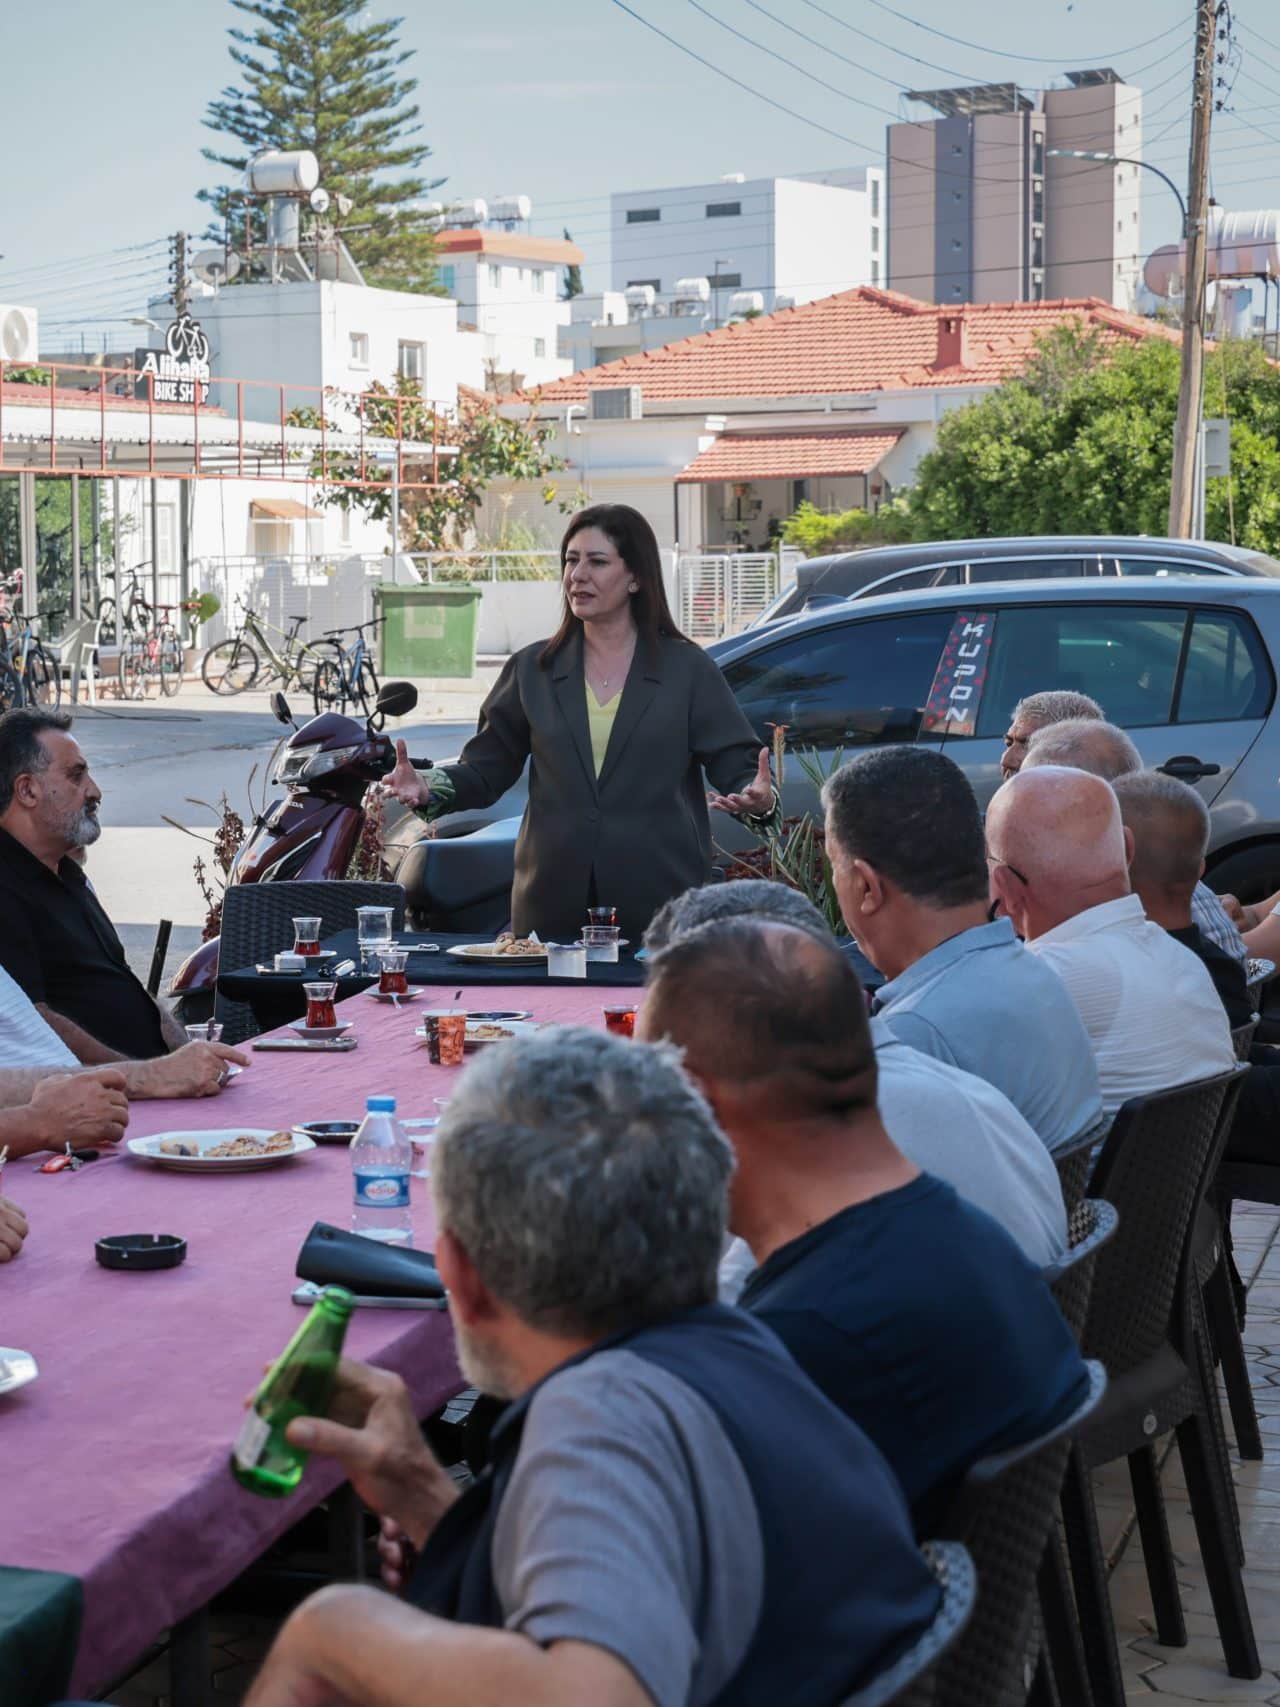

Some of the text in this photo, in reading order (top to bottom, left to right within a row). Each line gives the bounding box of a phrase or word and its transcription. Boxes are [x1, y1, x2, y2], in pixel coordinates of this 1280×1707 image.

[153, 381, 209, 403] BIKE SHP
[945, 622, 986, 722] KUPON
